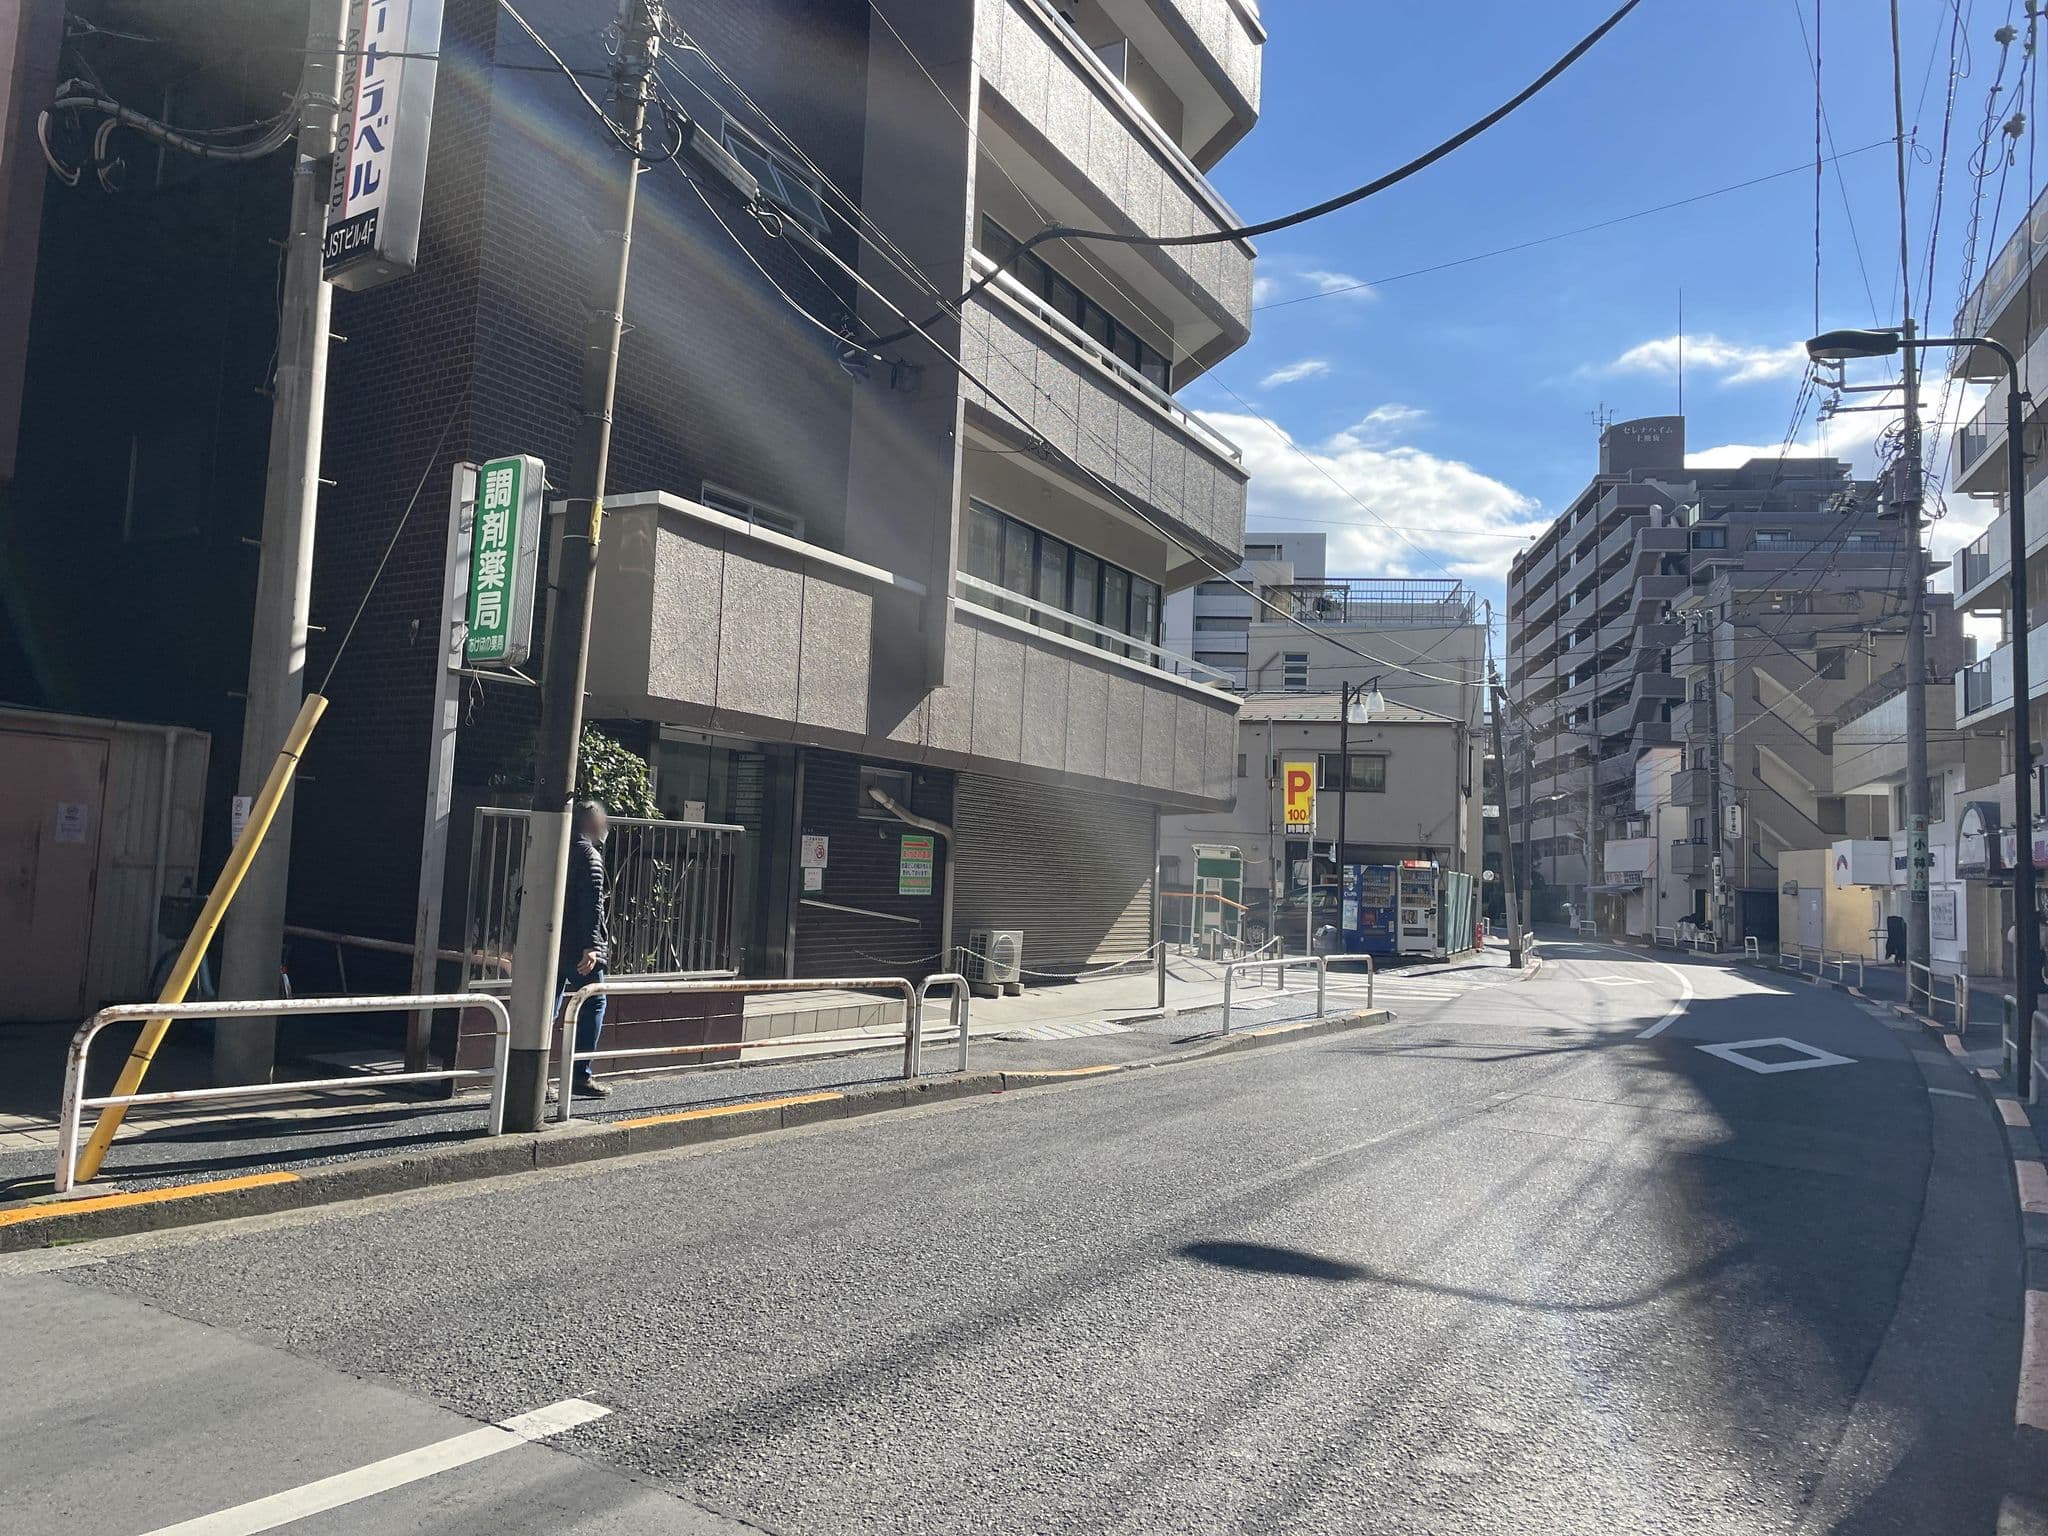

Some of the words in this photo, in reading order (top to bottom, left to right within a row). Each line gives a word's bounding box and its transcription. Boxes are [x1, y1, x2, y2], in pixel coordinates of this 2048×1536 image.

[341, 28, 360, 113] AGENCY
[349, 0, 390, 201] ートラベル
[325, 217, 376, 259] JSTビル4F
[473, 467, 514, 631] 調剤薬局
[1287, 770, 1312, 806] P
[1287, 808, 1307, 821] 100
